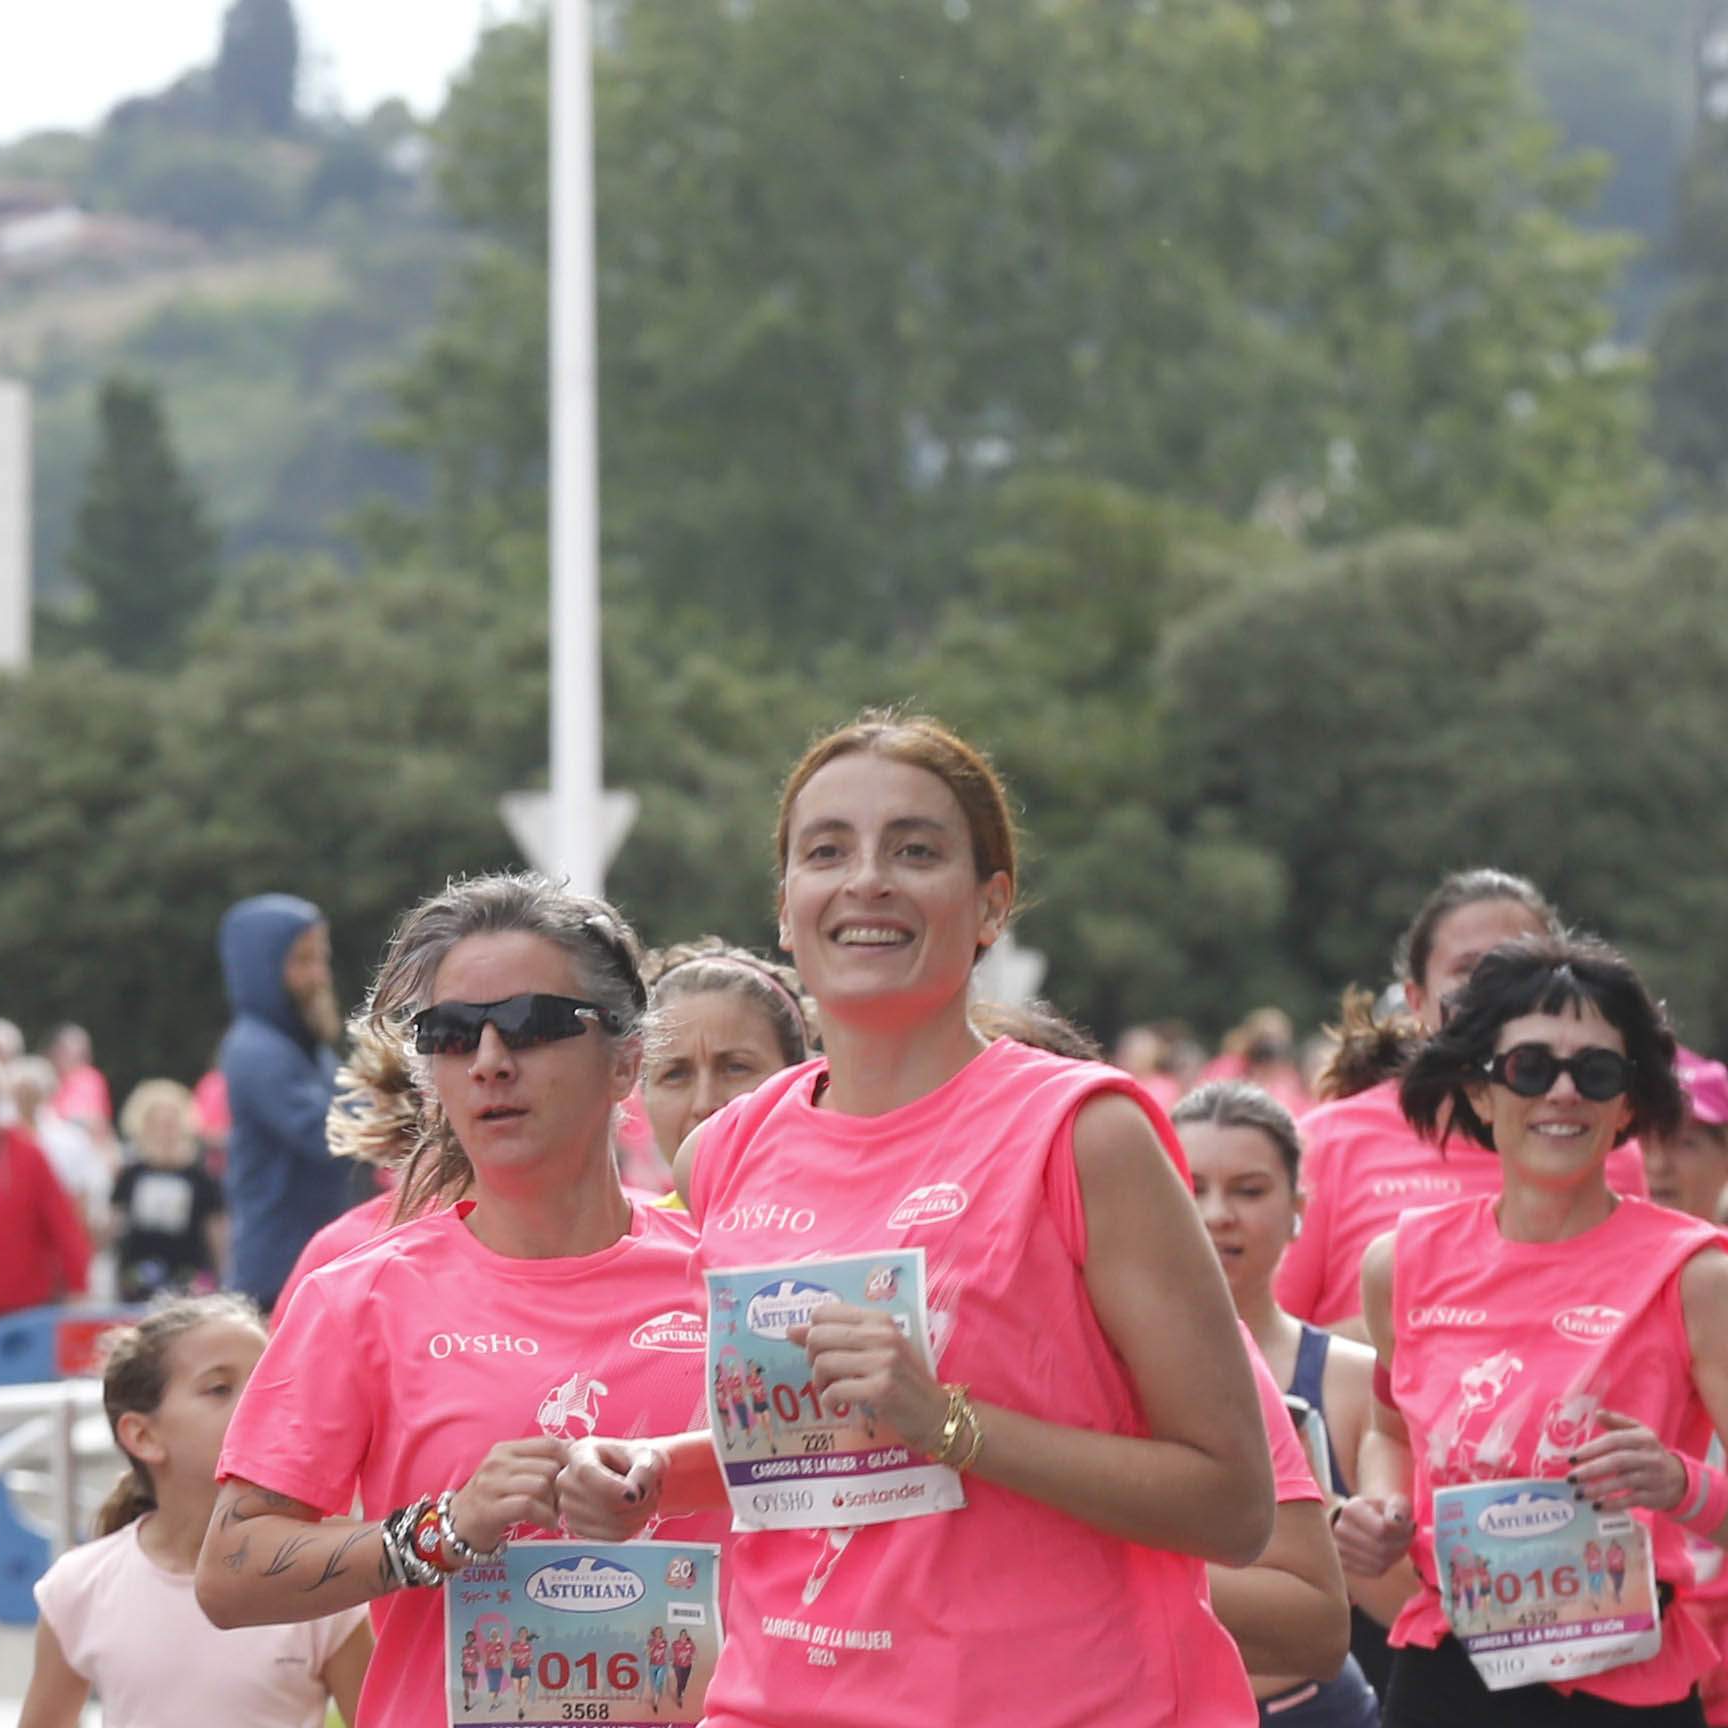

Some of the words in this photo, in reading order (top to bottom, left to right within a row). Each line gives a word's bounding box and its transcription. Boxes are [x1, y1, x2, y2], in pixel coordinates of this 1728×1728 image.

[718, 1202, 816, 1233] OYSHO
[429, 1332, 539, 1359] OYSHO
[751, 1463, 800, 1479] CARRERA
[801, 1460, 813, 1475] DE
[814, 1458, 826, 1474] LA
[752, 1489, 814, 1514] OYSHO
[845, 1484, 925, 1508] Santander
[1485, 1510, 1570, 1532] ASTURIANA
[670, 1559, 693, 1578] 20
[535, 1577, 637, 1599] ASTURIANA
[1494, 1565, 1580, 1605] 016
[762, 1616, 811, 1642] CARRERA
[811, 1625, 830, 1645] DE
[829, 1627, 842, 1648] LA
[845, 1630, 892, 1650] MUJER
[538, 1652, 640, 1691] 016
[562, 1703, 609, 1720] 3568
